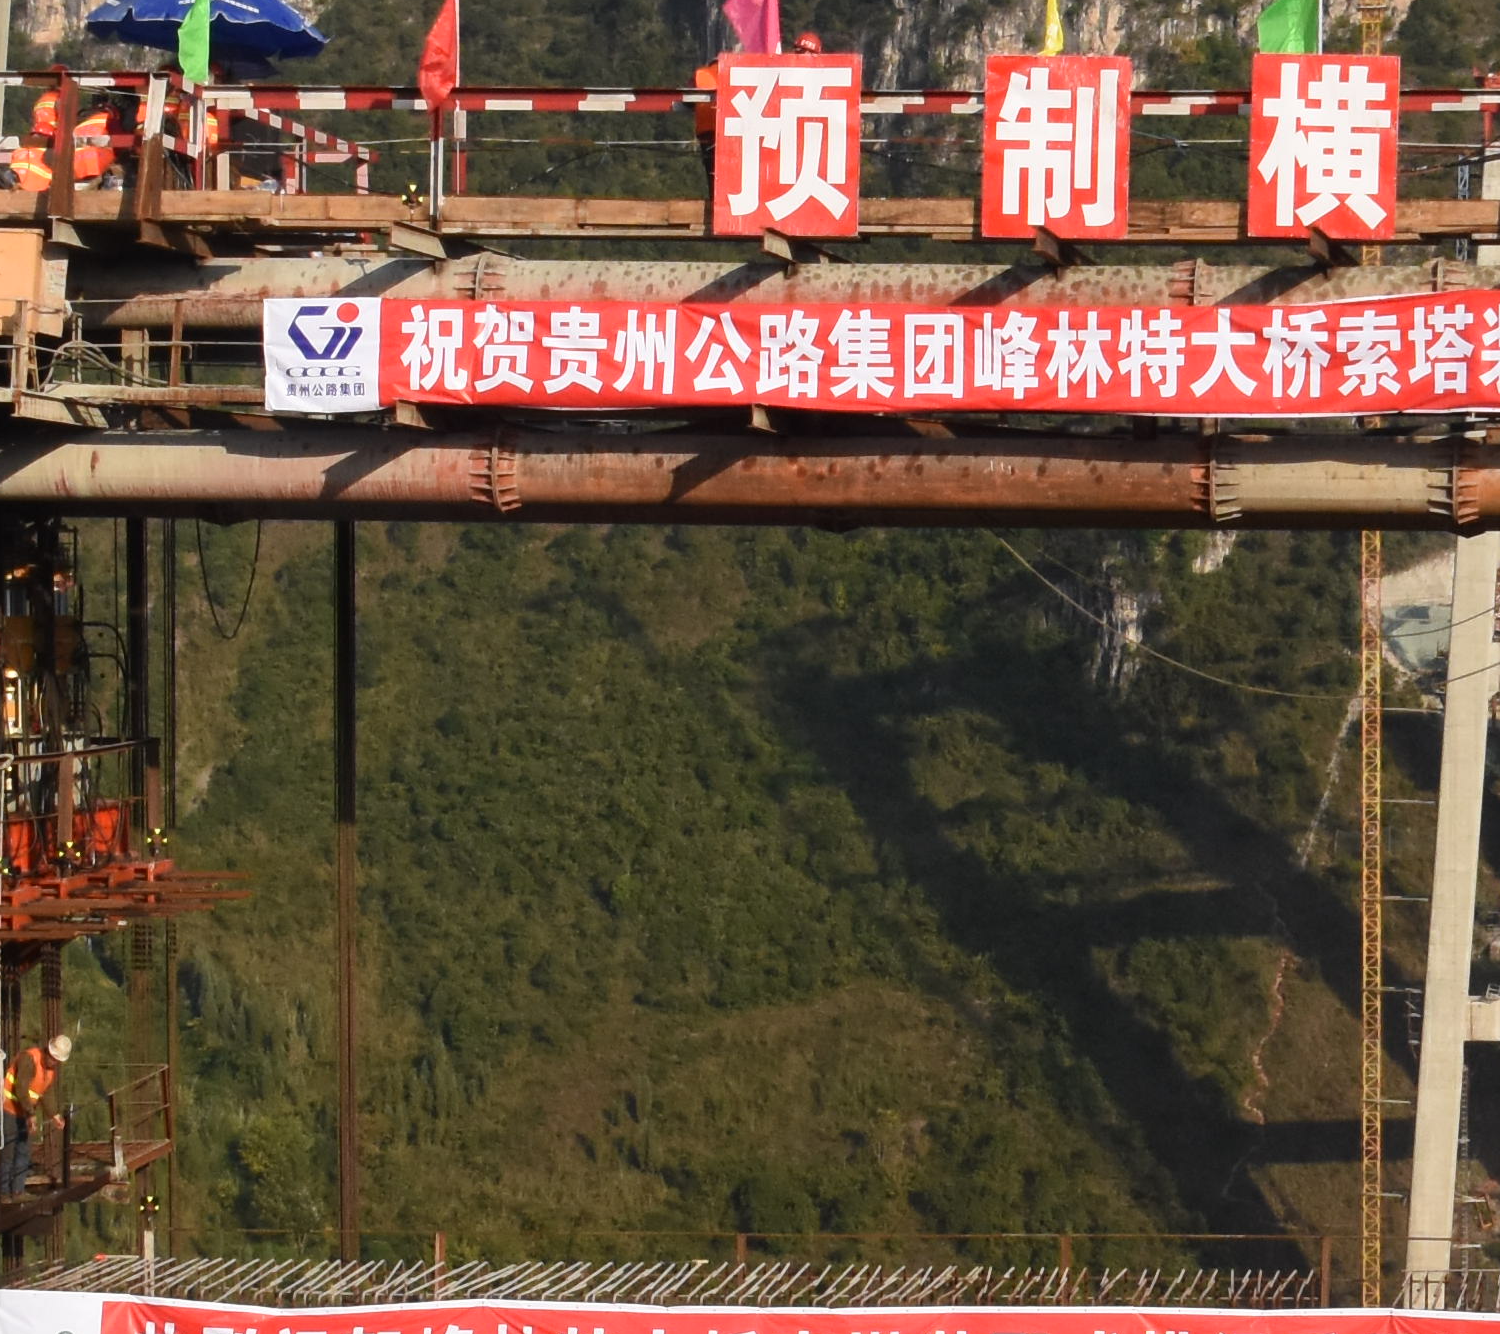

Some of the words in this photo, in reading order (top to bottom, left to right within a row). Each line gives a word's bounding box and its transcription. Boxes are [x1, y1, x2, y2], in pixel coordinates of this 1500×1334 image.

[724, 67, 852, 221] 预
[996, 67, 1119, 226] 制
[1258, 63, 1391, 229] 横
[286, 382, 365, 397] 贵州公路集团
